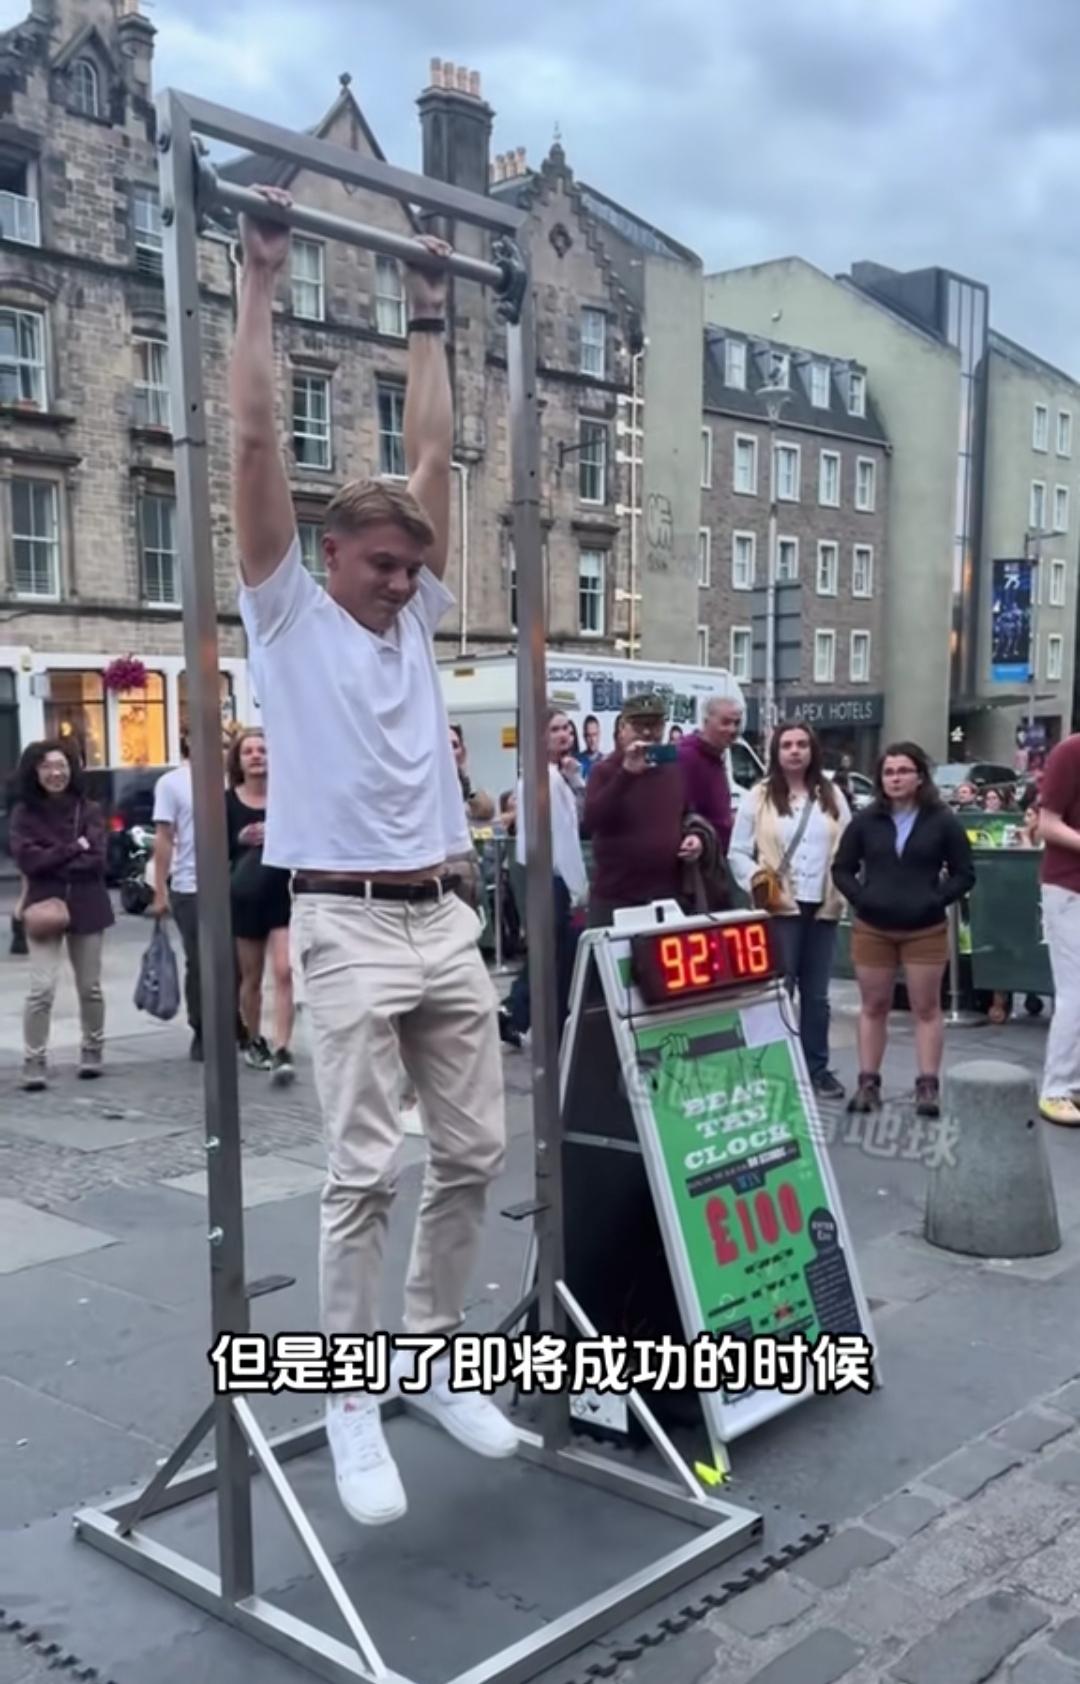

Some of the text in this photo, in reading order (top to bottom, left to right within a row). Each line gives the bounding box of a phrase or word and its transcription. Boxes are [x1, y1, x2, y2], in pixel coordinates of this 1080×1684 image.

[794, 704, 824, 720] APEX
[829, 702, 873, 720] HOTELS
[661, 924, 769, 989] 92:78
[682, 1078, 768, 1118] BEAT
[684, 1122, 792, 1169] CLOCK
[705, 1183, 804, 1268] £100
